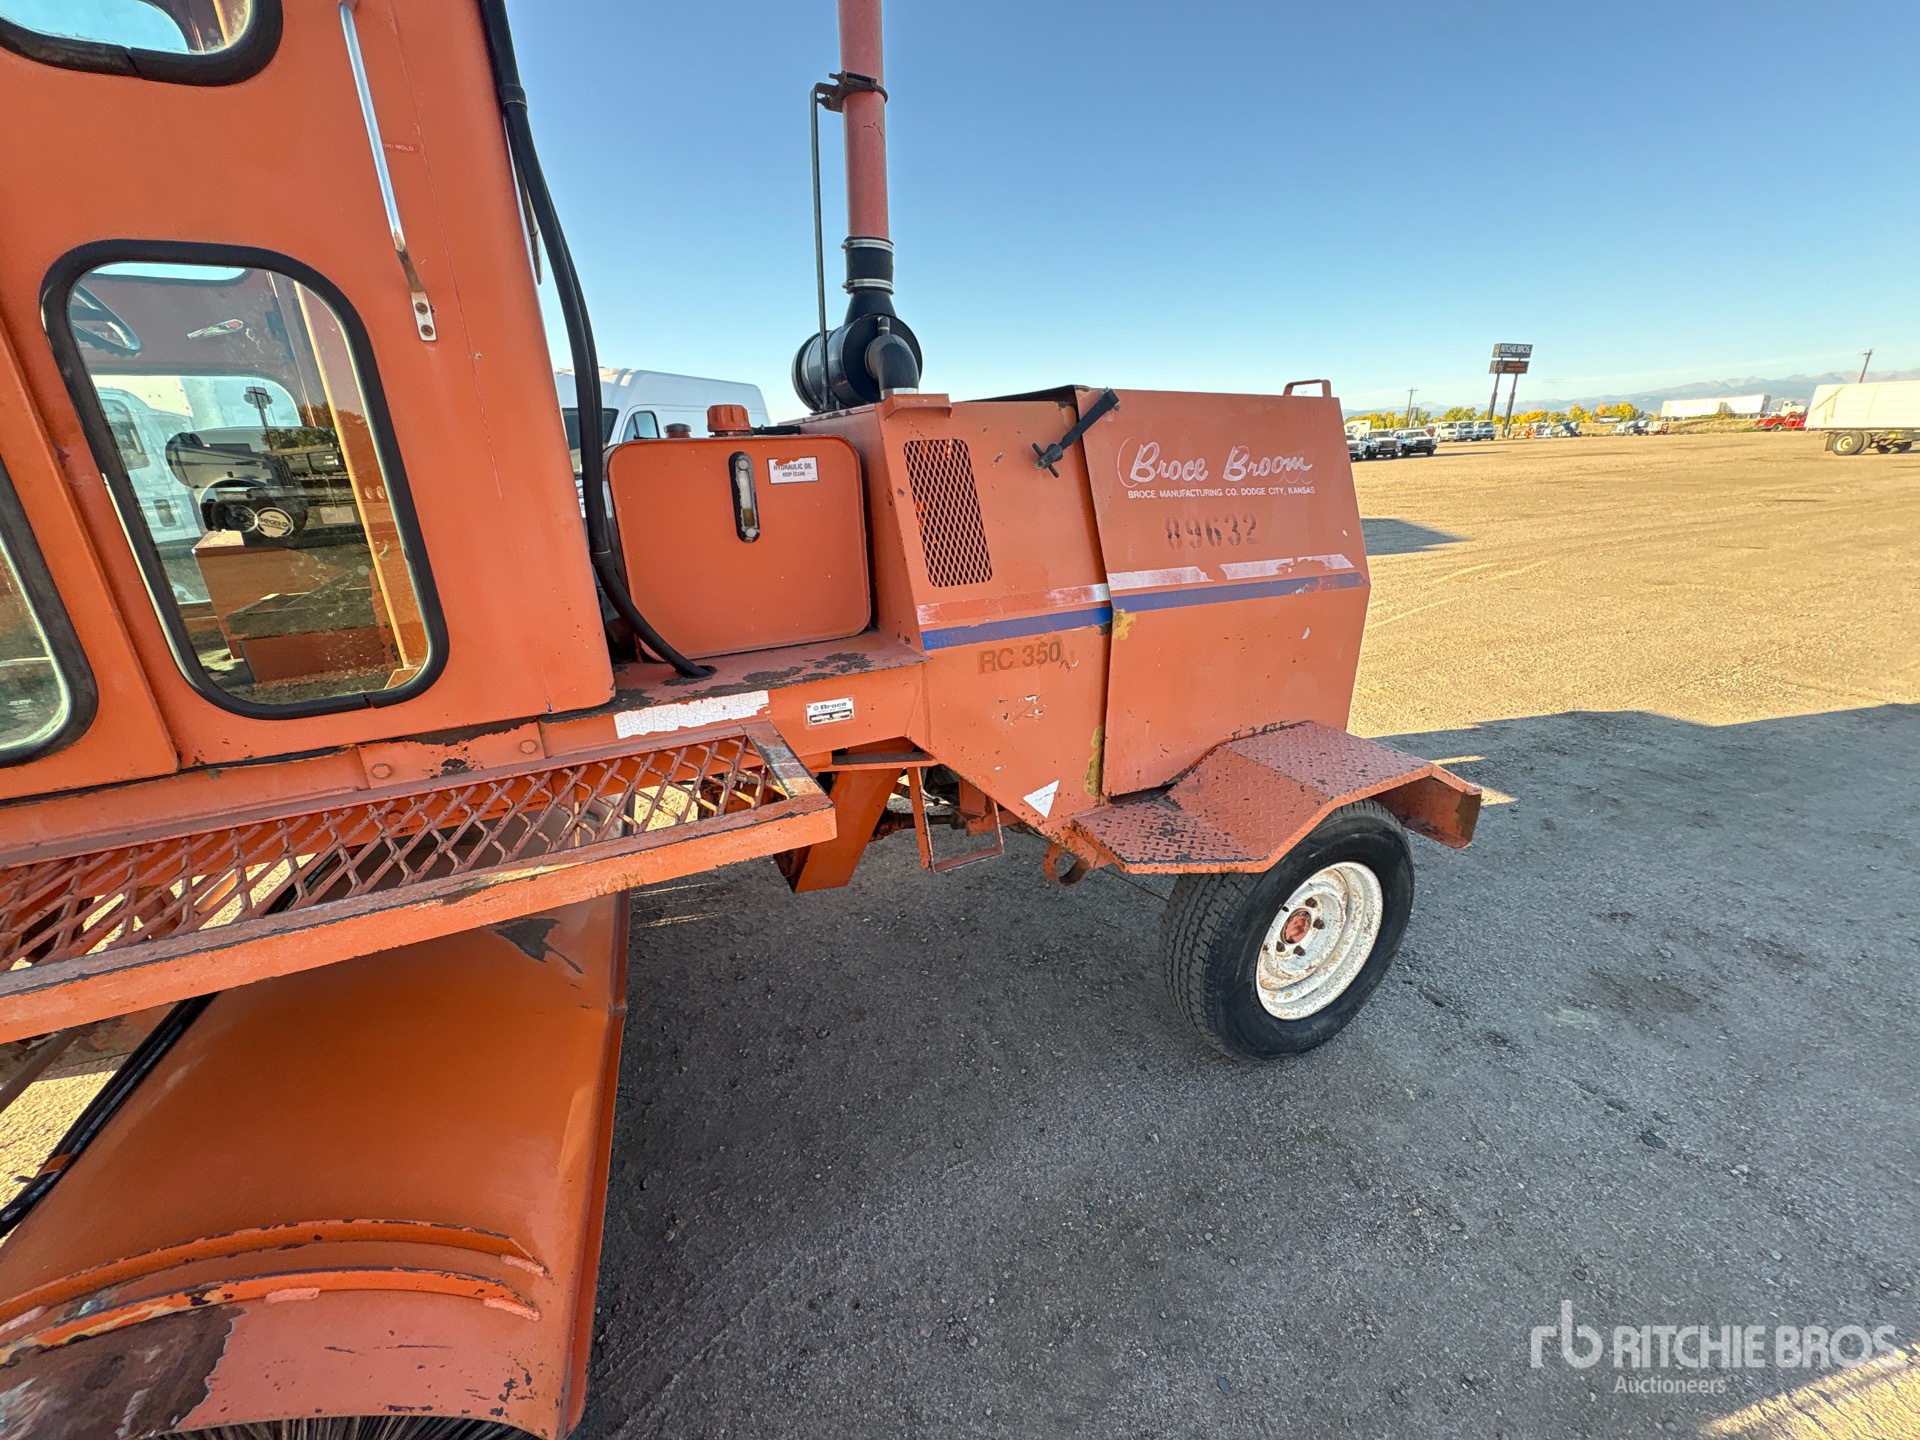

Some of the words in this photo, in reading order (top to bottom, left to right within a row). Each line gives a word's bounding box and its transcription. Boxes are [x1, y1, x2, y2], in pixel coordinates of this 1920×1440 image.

[1501, 344, 1517, 353] RITCHIE
[773, 463, 803, 471] HYDRAULIC
[803, 462, 813, 470] OIL
[1130, 441, 1209, 482] Broce
[1223, 445, 1313, 482] Broom
[1128, 489, 1157, 499] BROCE
[1159, 488, 1223, 498] MANUFACTURING
[1225, 488, 1239, 496] CO.
[1240, 487, 1266, 496] DODGE
[1268, 486, 1287, 496] CITY,
[1287, 486, 1316, 495] KANSAS
[979, 647, 1014, 673] RC
[1022, 640, 1061, 667] 350
